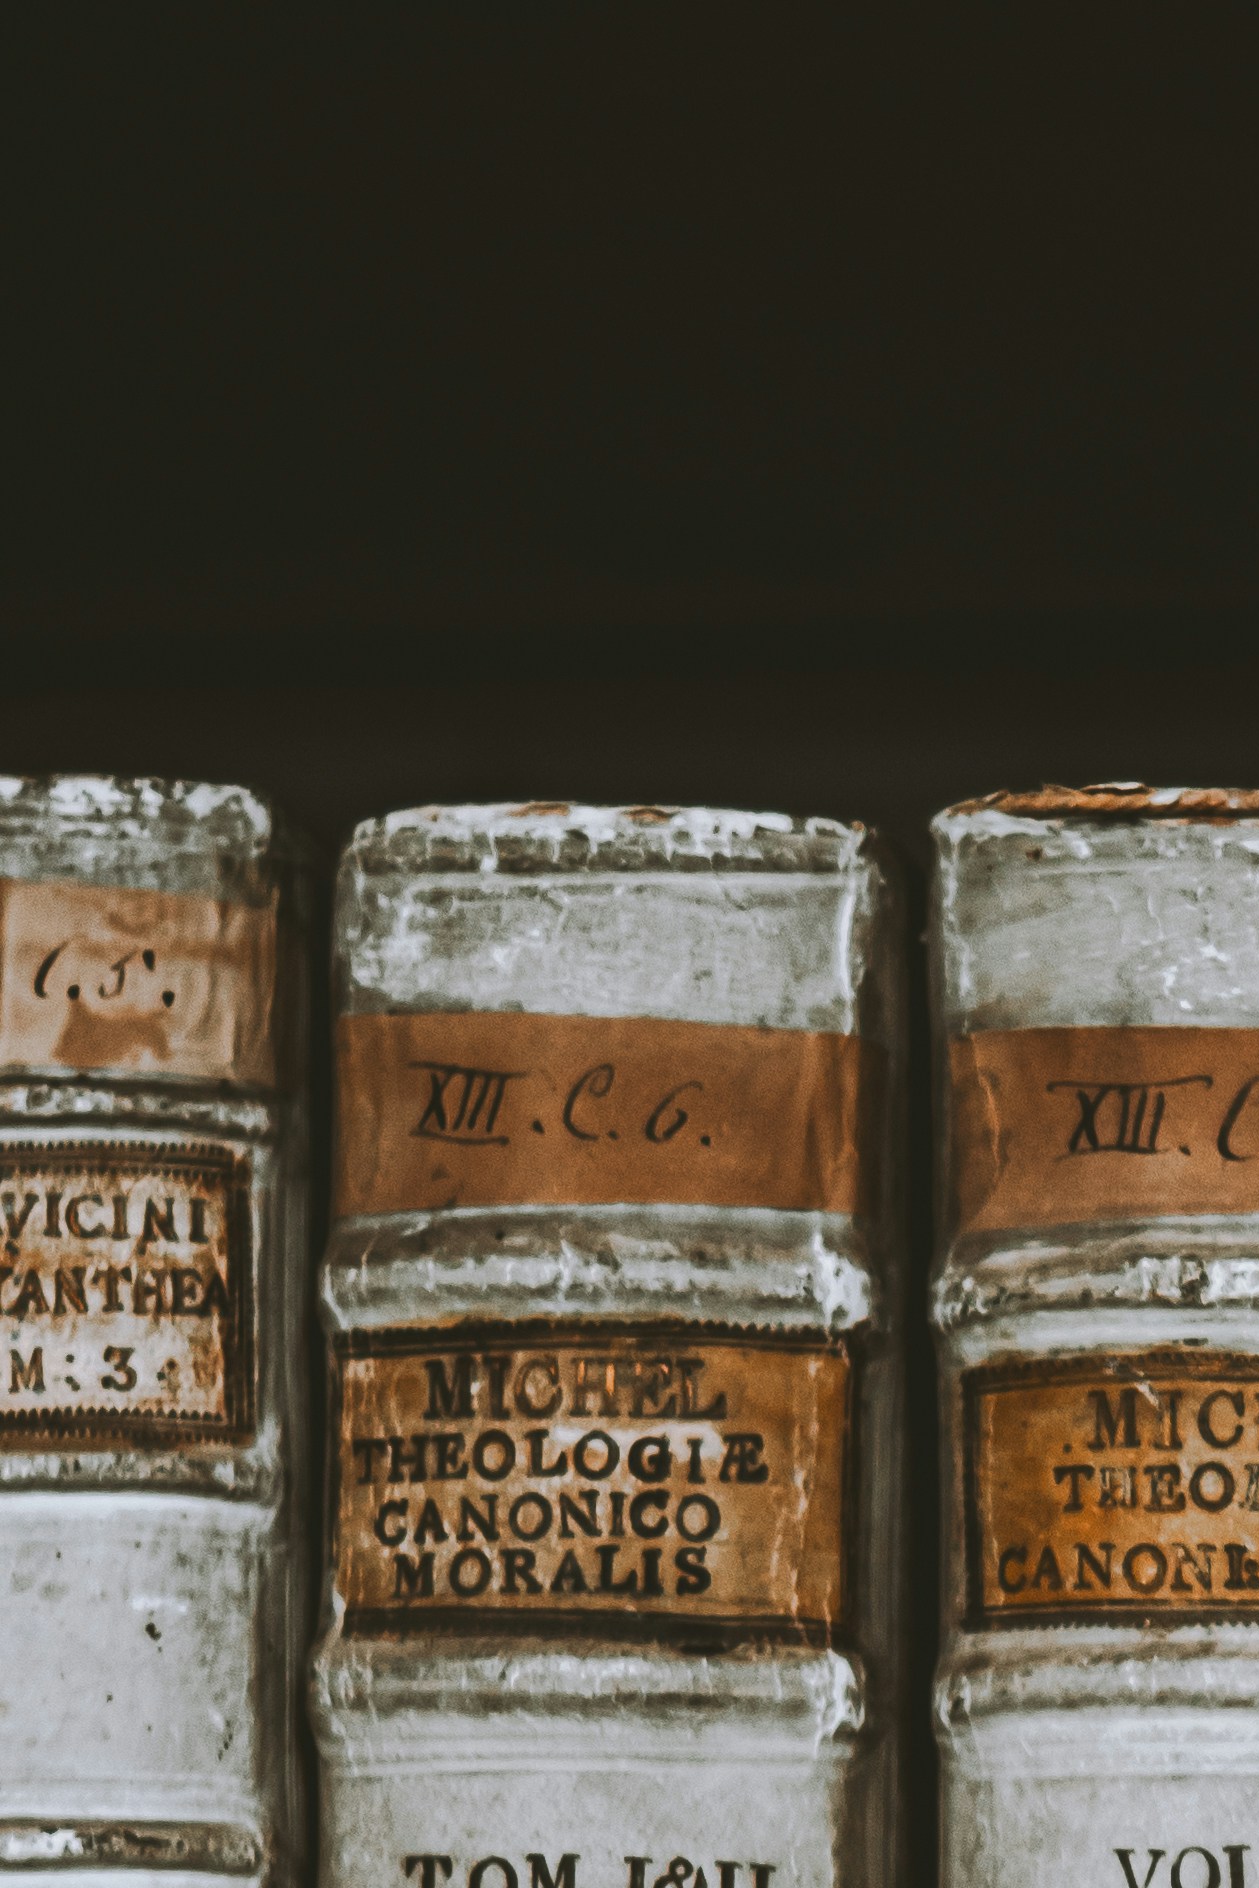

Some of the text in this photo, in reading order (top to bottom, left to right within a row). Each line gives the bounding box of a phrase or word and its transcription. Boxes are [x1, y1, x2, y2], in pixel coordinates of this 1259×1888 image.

[0, 1266, 230, 1318] ANTHEA
[422, 1356, 728, 1422] MICHEL
[373, 1489, 722, 1547] CANONICO
[390, 1545, 713, 1599] MORALIS
